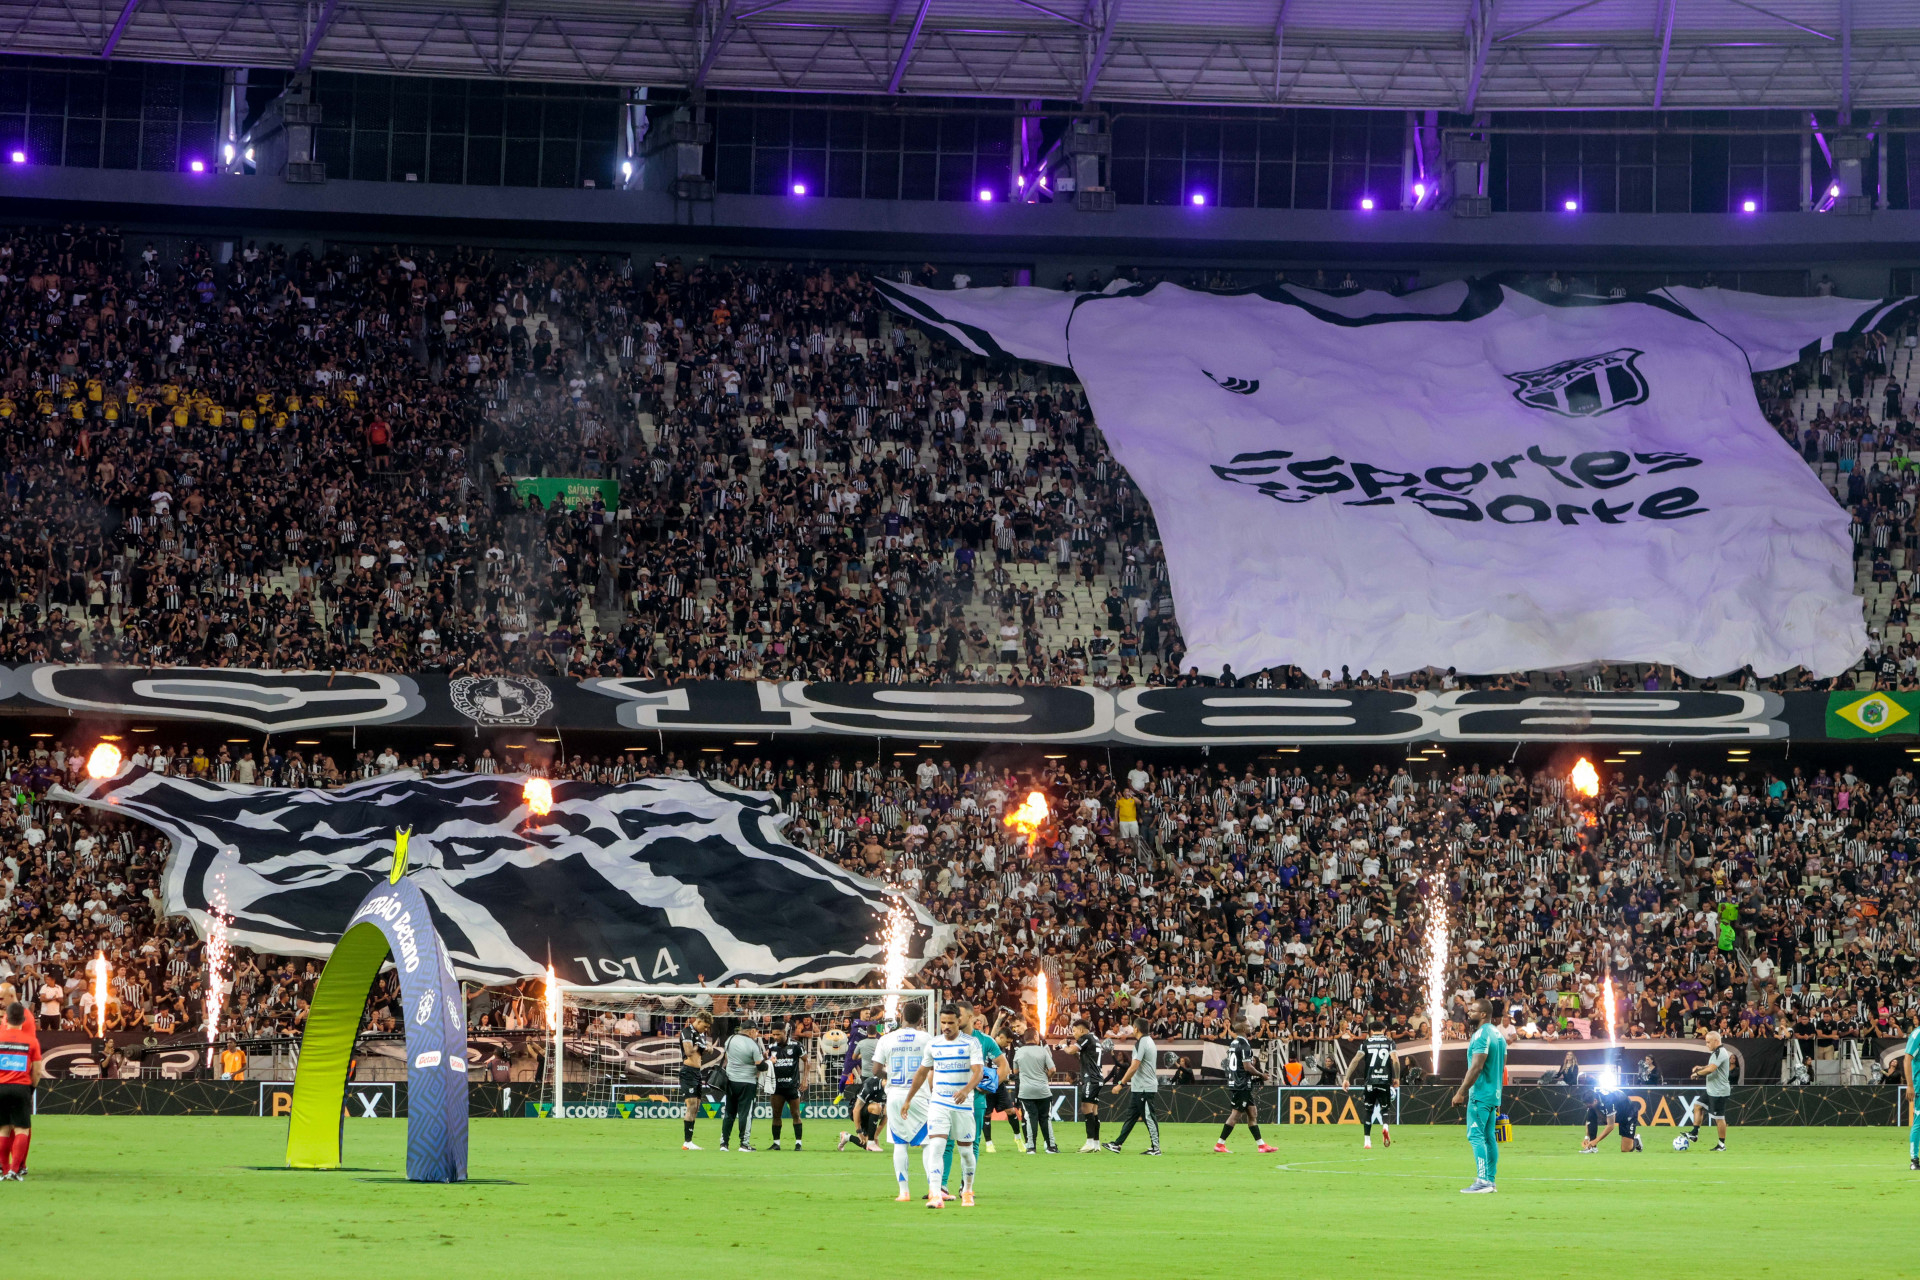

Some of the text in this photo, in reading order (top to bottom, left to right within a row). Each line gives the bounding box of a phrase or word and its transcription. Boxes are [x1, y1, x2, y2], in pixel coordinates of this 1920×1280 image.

[1526, 355, 1624, 394] CEARÁ
[567, 483, 589, 495] SAÍDA
[592, 677, 1785, 744] 1982
[392, 911, 420, 973] Betano
[573, 947, 681, 982] 1914
[419, 1055, 439, 1065] Betano
[891, 1056, 922, 1085] 99
[941, 1061, 967, 1069] betfair
[1368, 1048, 1389, 1067] 79
[272, 1092, 383, 1118] BX
[805, 1105, 849, 1119] SICOO
